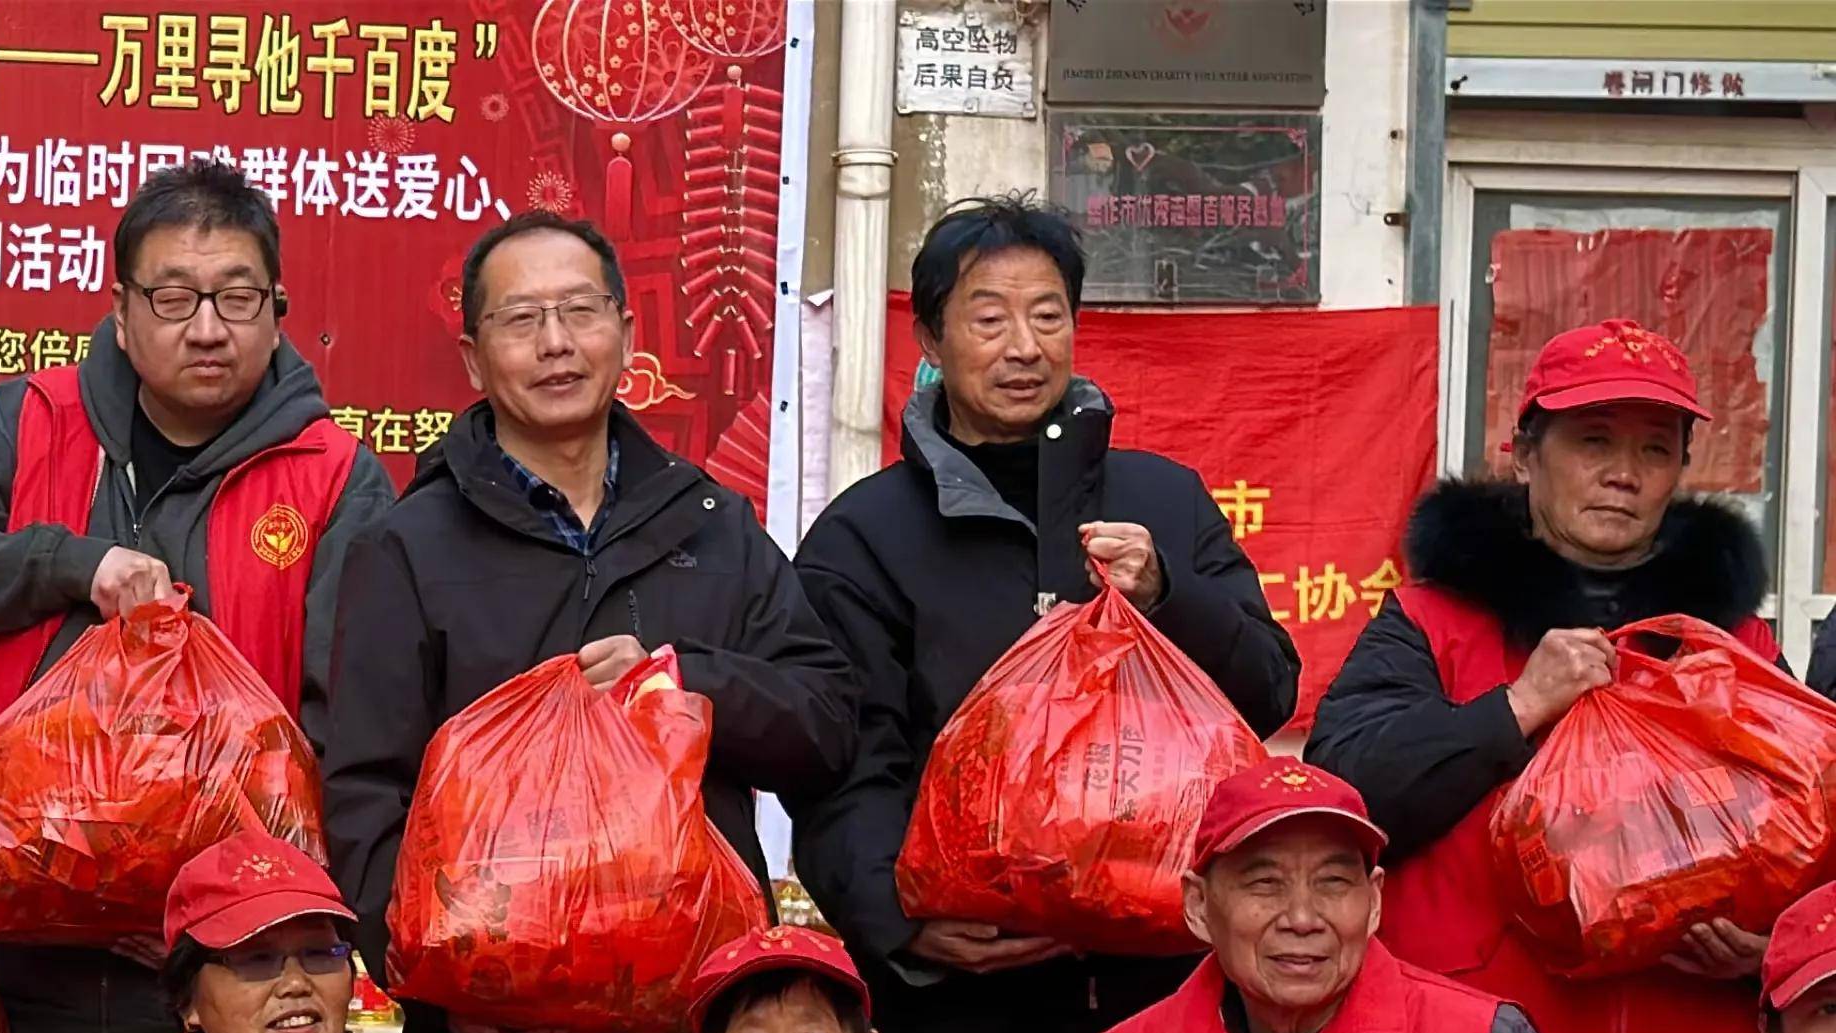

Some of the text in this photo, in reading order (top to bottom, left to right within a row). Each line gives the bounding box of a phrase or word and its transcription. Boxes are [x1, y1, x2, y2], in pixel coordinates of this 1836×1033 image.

[915, 27, 1018, 54] 高空坠物
[913, 63, 1014, 91] 后果自负
[1212, 480, 1271, 539] 市
